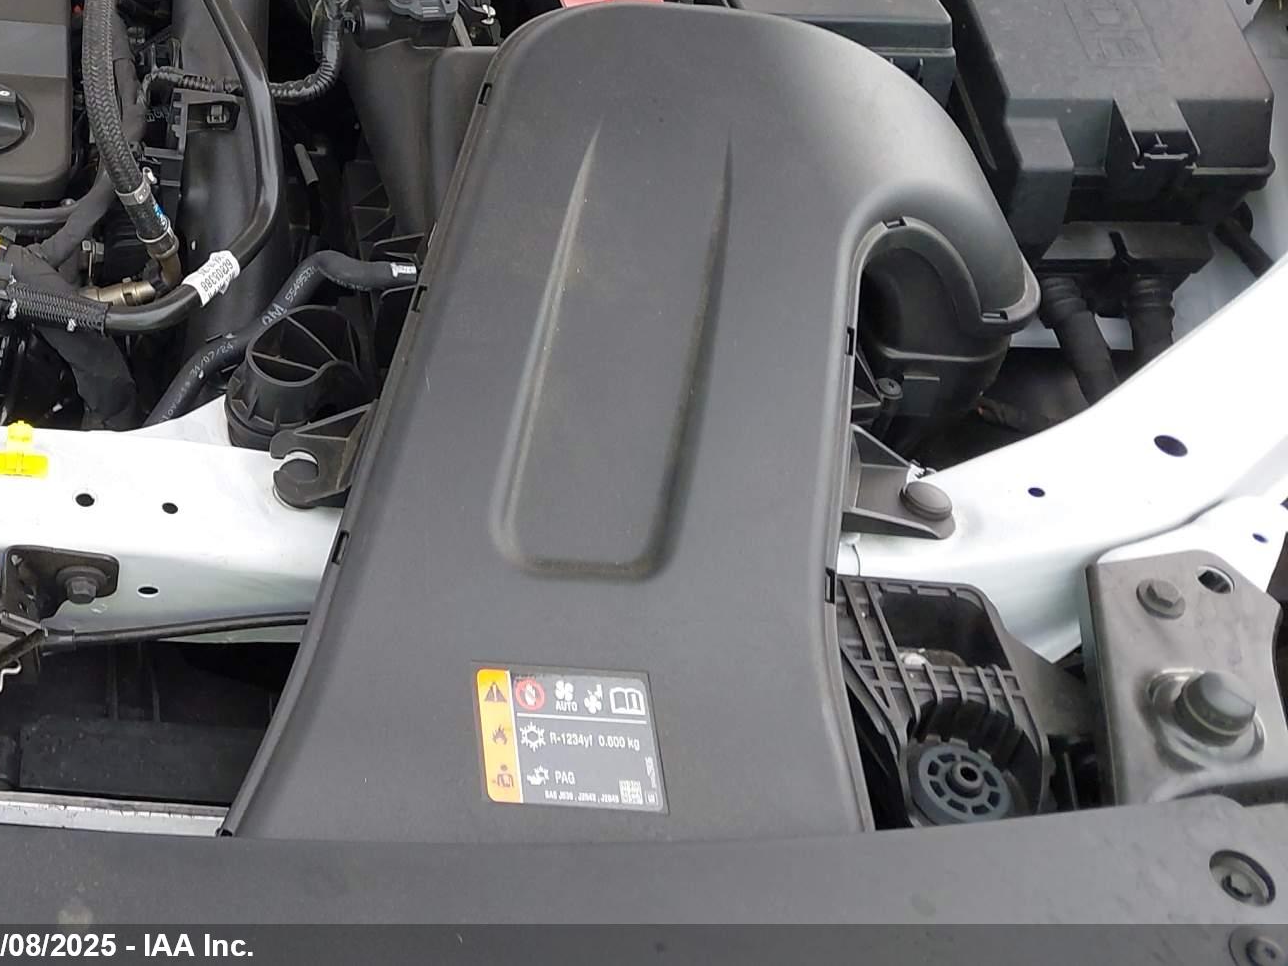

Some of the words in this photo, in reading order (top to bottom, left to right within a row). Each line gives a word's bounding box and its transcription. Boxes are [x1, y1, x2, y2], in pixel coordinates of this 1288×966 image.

[555, 701, 578, 712] AUTO
[550, 732, 593, 748] R-1234yf
[628, 737, 640, 751] kg
[554, 771, 576, 784] PAG
